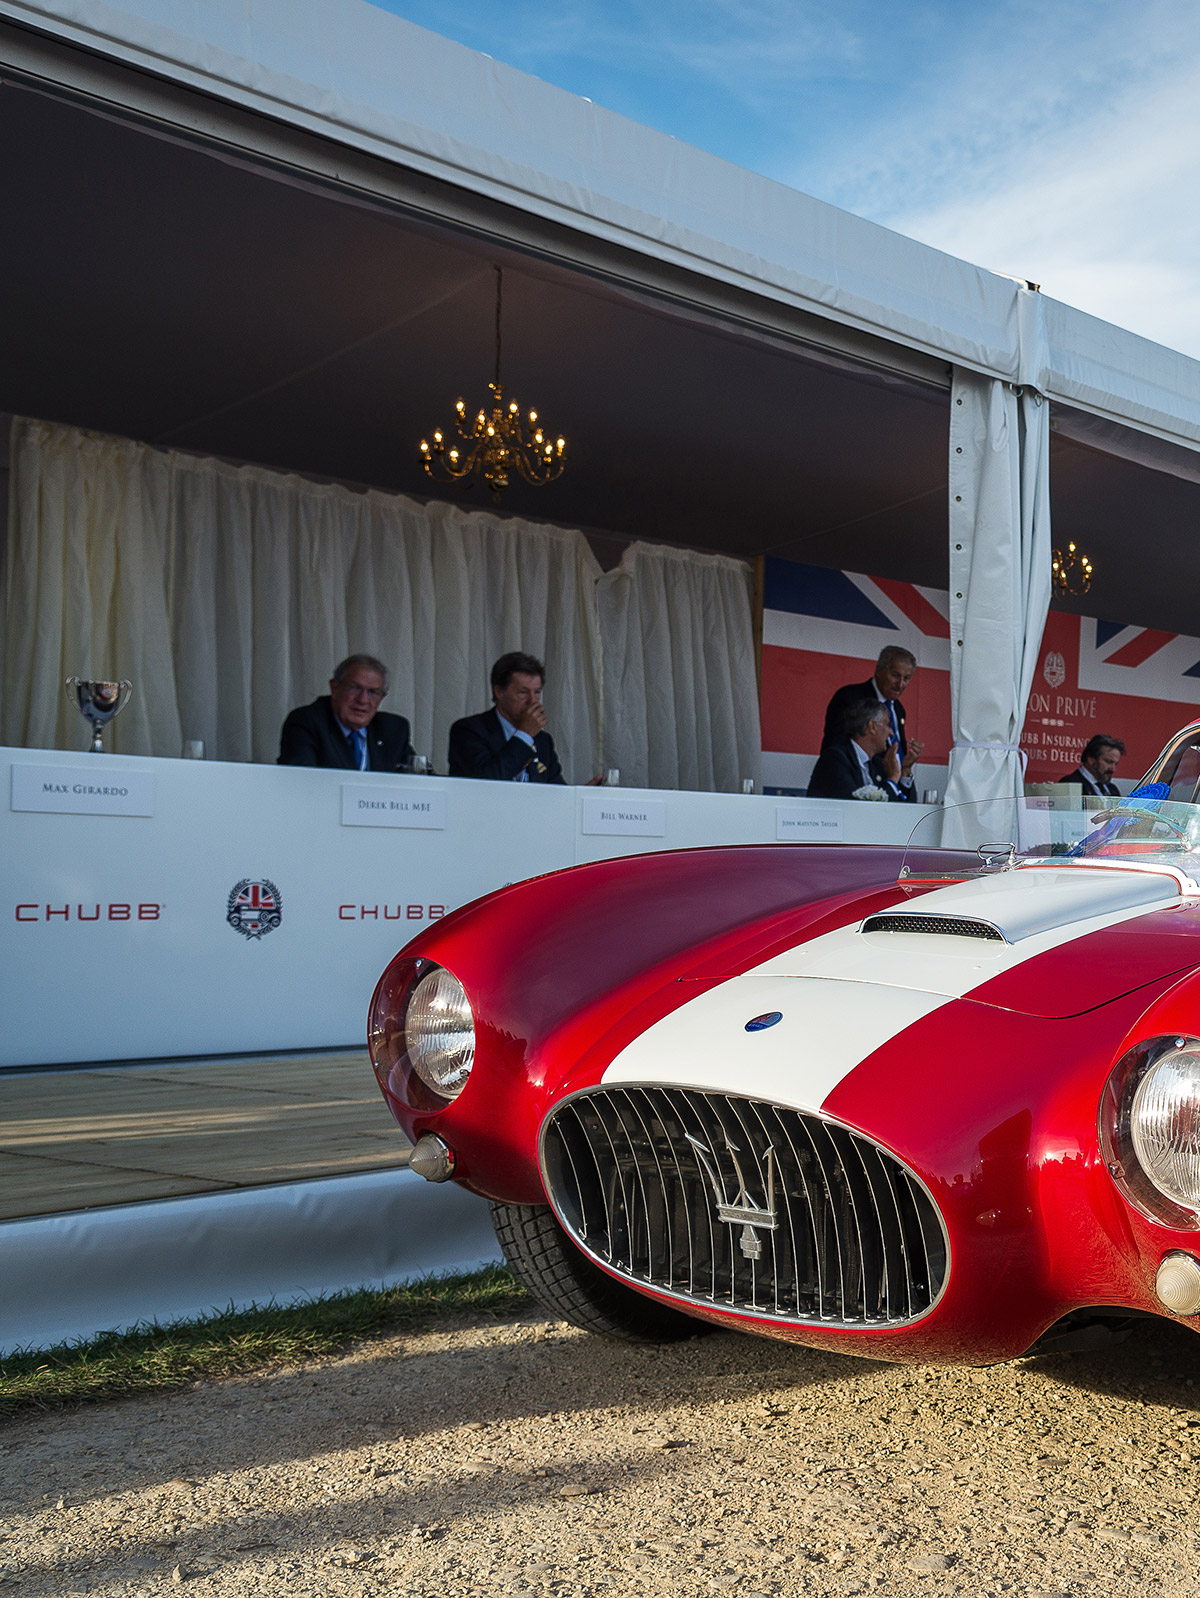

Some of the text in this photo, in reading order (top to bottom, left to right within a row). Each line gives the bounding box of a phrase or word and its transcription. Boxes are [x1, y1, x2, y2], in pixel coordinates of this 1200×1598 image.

[1027, 693, 1097, 718] ON PRIVÉ
[1020, 732, 1039, 744] UBB
[1051, 748, 1082, 763] D'ELÉG
[42, 783, 129, 797] MAX GIRARDO
[358, 799, 431, 812] DEREK BELL MBE
[601, 811, 648, 821] BILL WARNER
[15, 903, 160, 922] CHUBB
[338, 904, 445, 920] CHUBB
